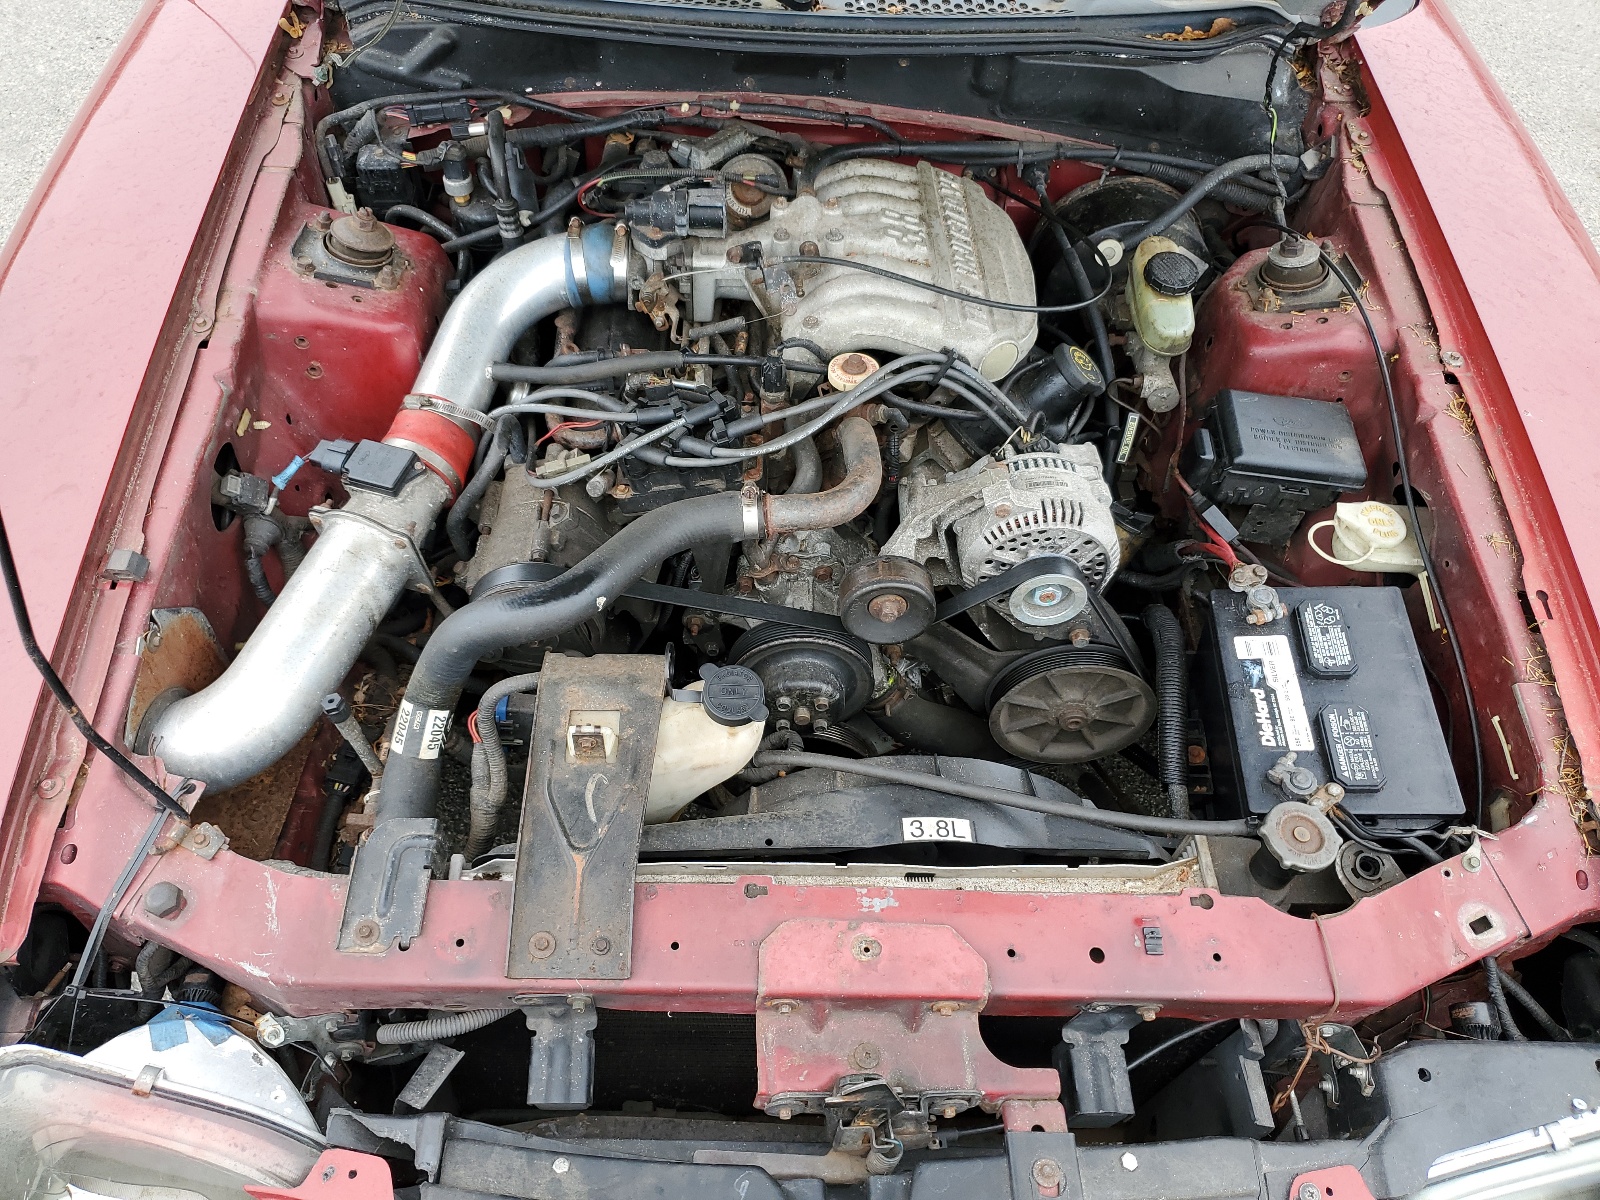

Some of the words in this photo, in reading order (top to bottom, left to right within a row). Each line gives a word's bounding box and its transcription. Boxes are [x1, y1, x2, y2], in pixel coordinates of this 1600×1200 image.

[720, 687, 748, 696] ONLY
[395, 707, 411, 746] 22045
[1250, 688, 1277, 747] DieHard
[1328, 713, 1340, 738] POISON
[427, 716, 447, 750] 22045
[1335, 744, 1348, 770] DANGER
[910, 820, 966, 838] 3.8L
